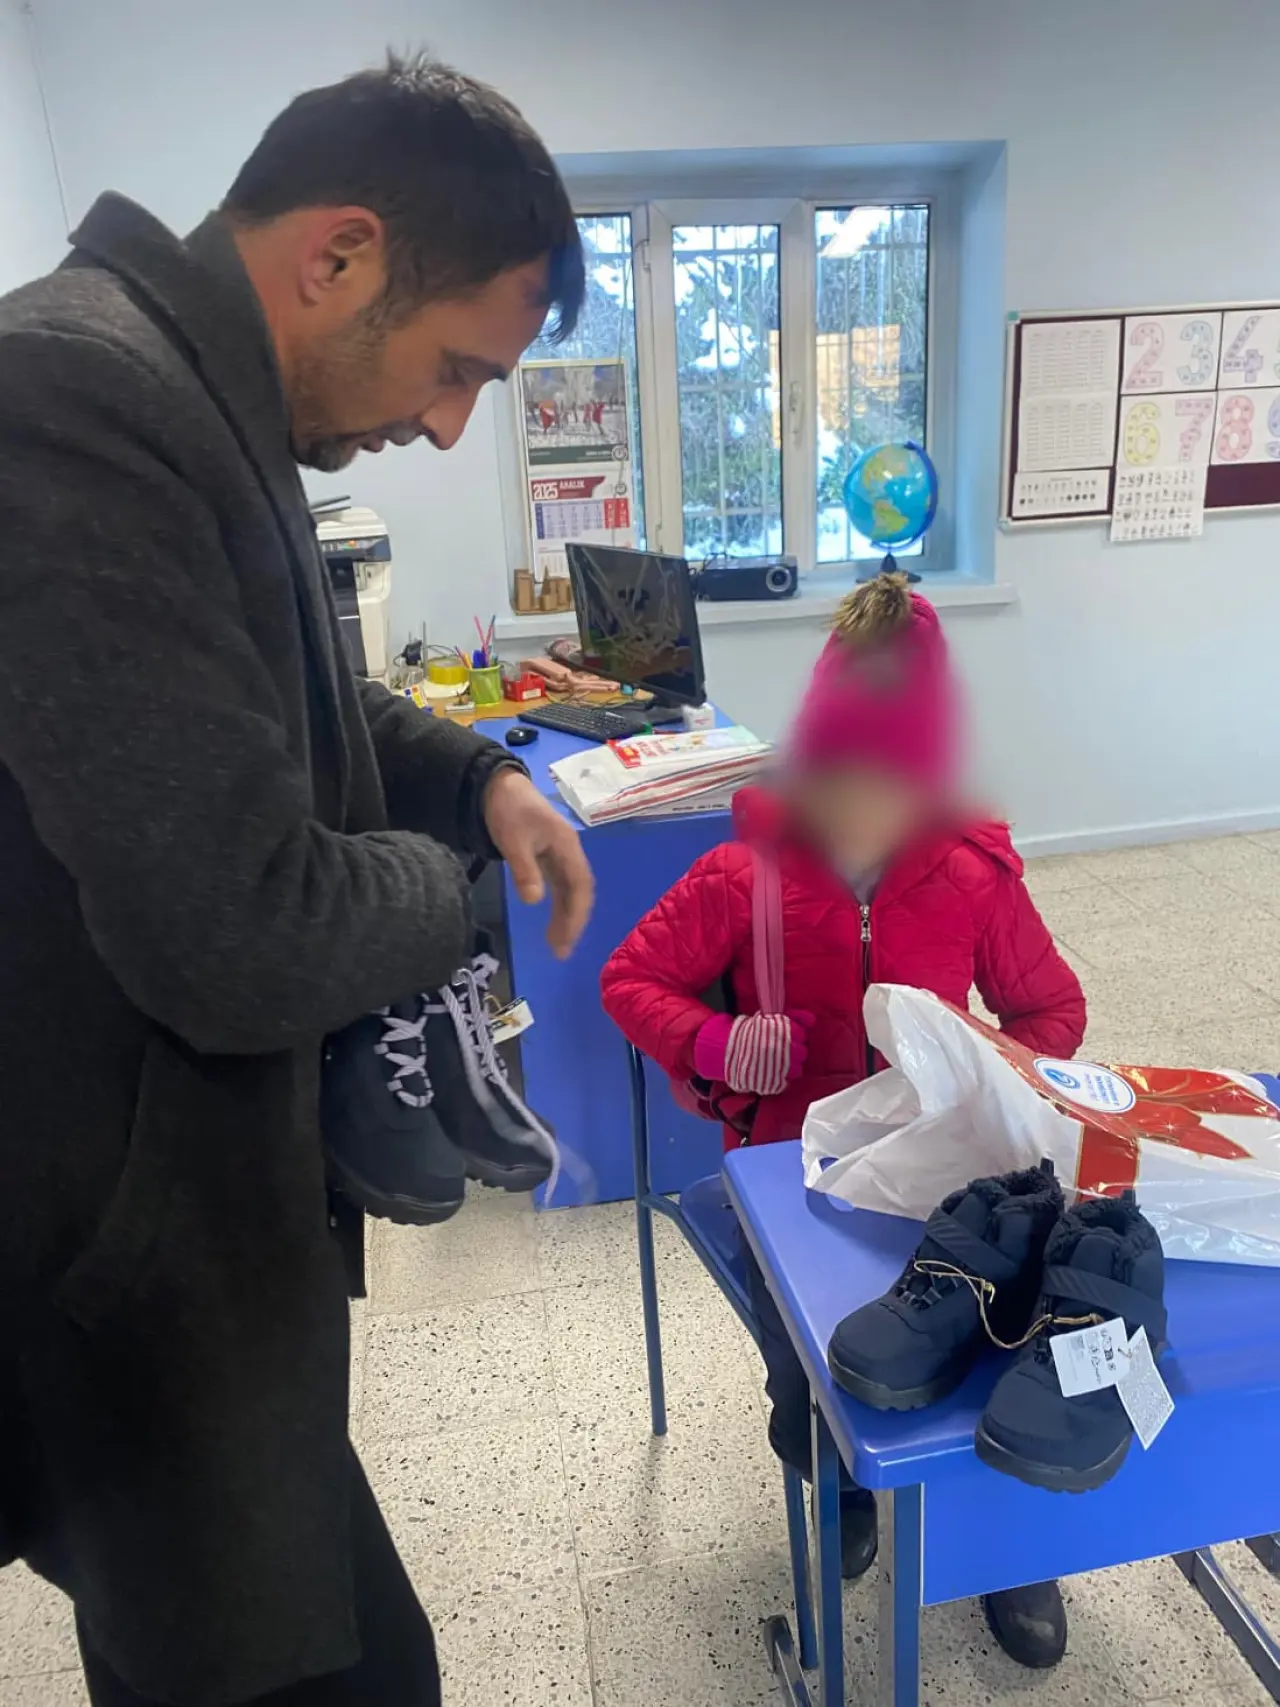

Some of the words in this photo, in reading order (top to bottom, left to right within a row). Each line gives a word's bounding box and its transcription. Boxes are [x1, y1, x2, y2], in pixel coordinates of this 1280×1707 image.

[1127, 322, 1164, 389] 2
[1177, 320, 1213, 385] 3
[1223, 315, 1263, 383] 4
[1123, 402, 1160, 466] 6
[1175, 399, 1213, 461] 7
[1217, 395, 1254, 461] 8
